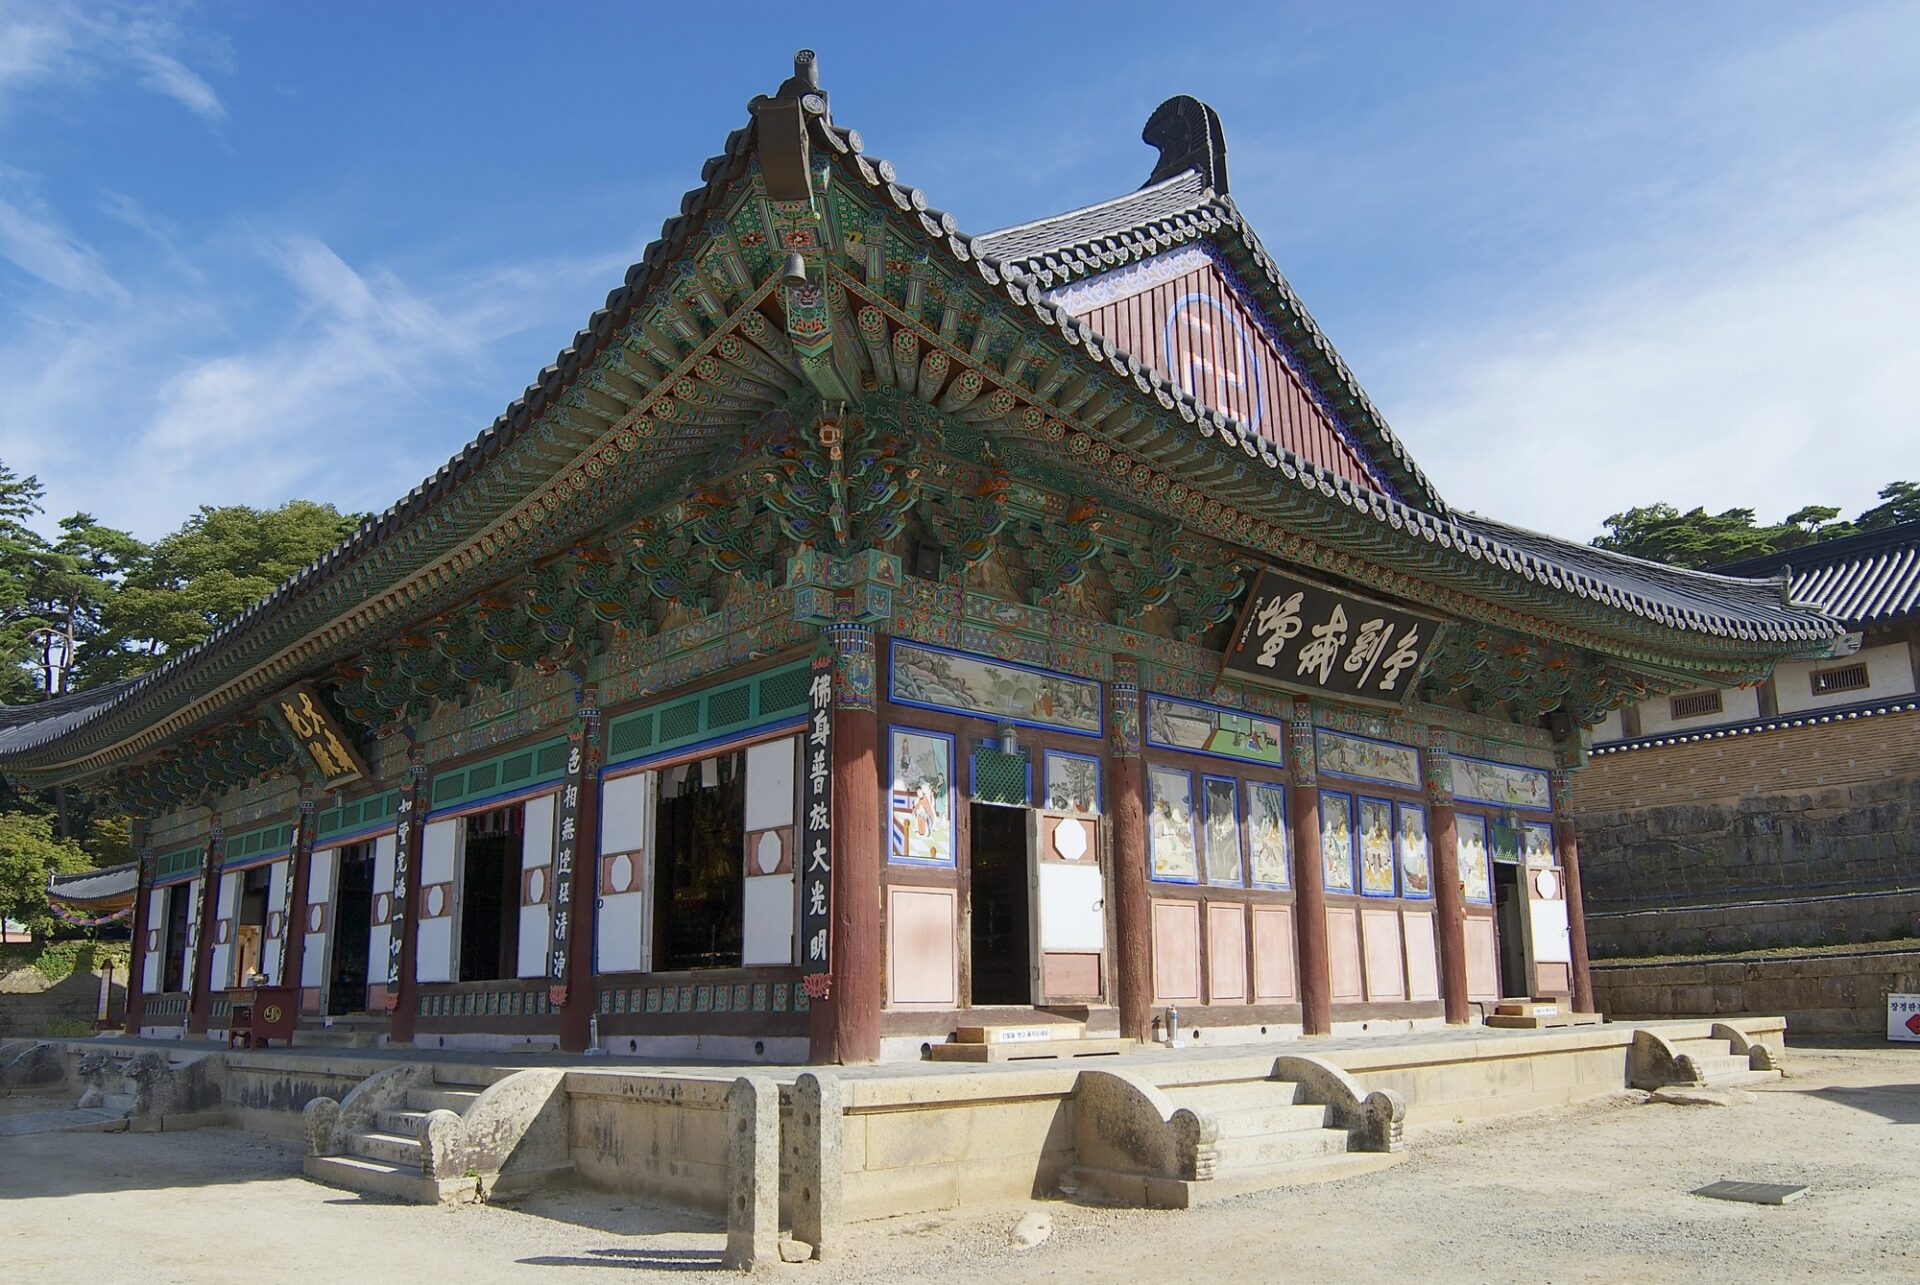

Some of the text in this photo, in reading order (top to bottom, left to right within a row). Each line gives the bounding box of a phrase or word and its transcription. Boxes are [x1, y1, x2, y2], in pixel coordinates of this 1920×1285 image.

[809, 674, 831, 962] 佛身普放大光明
